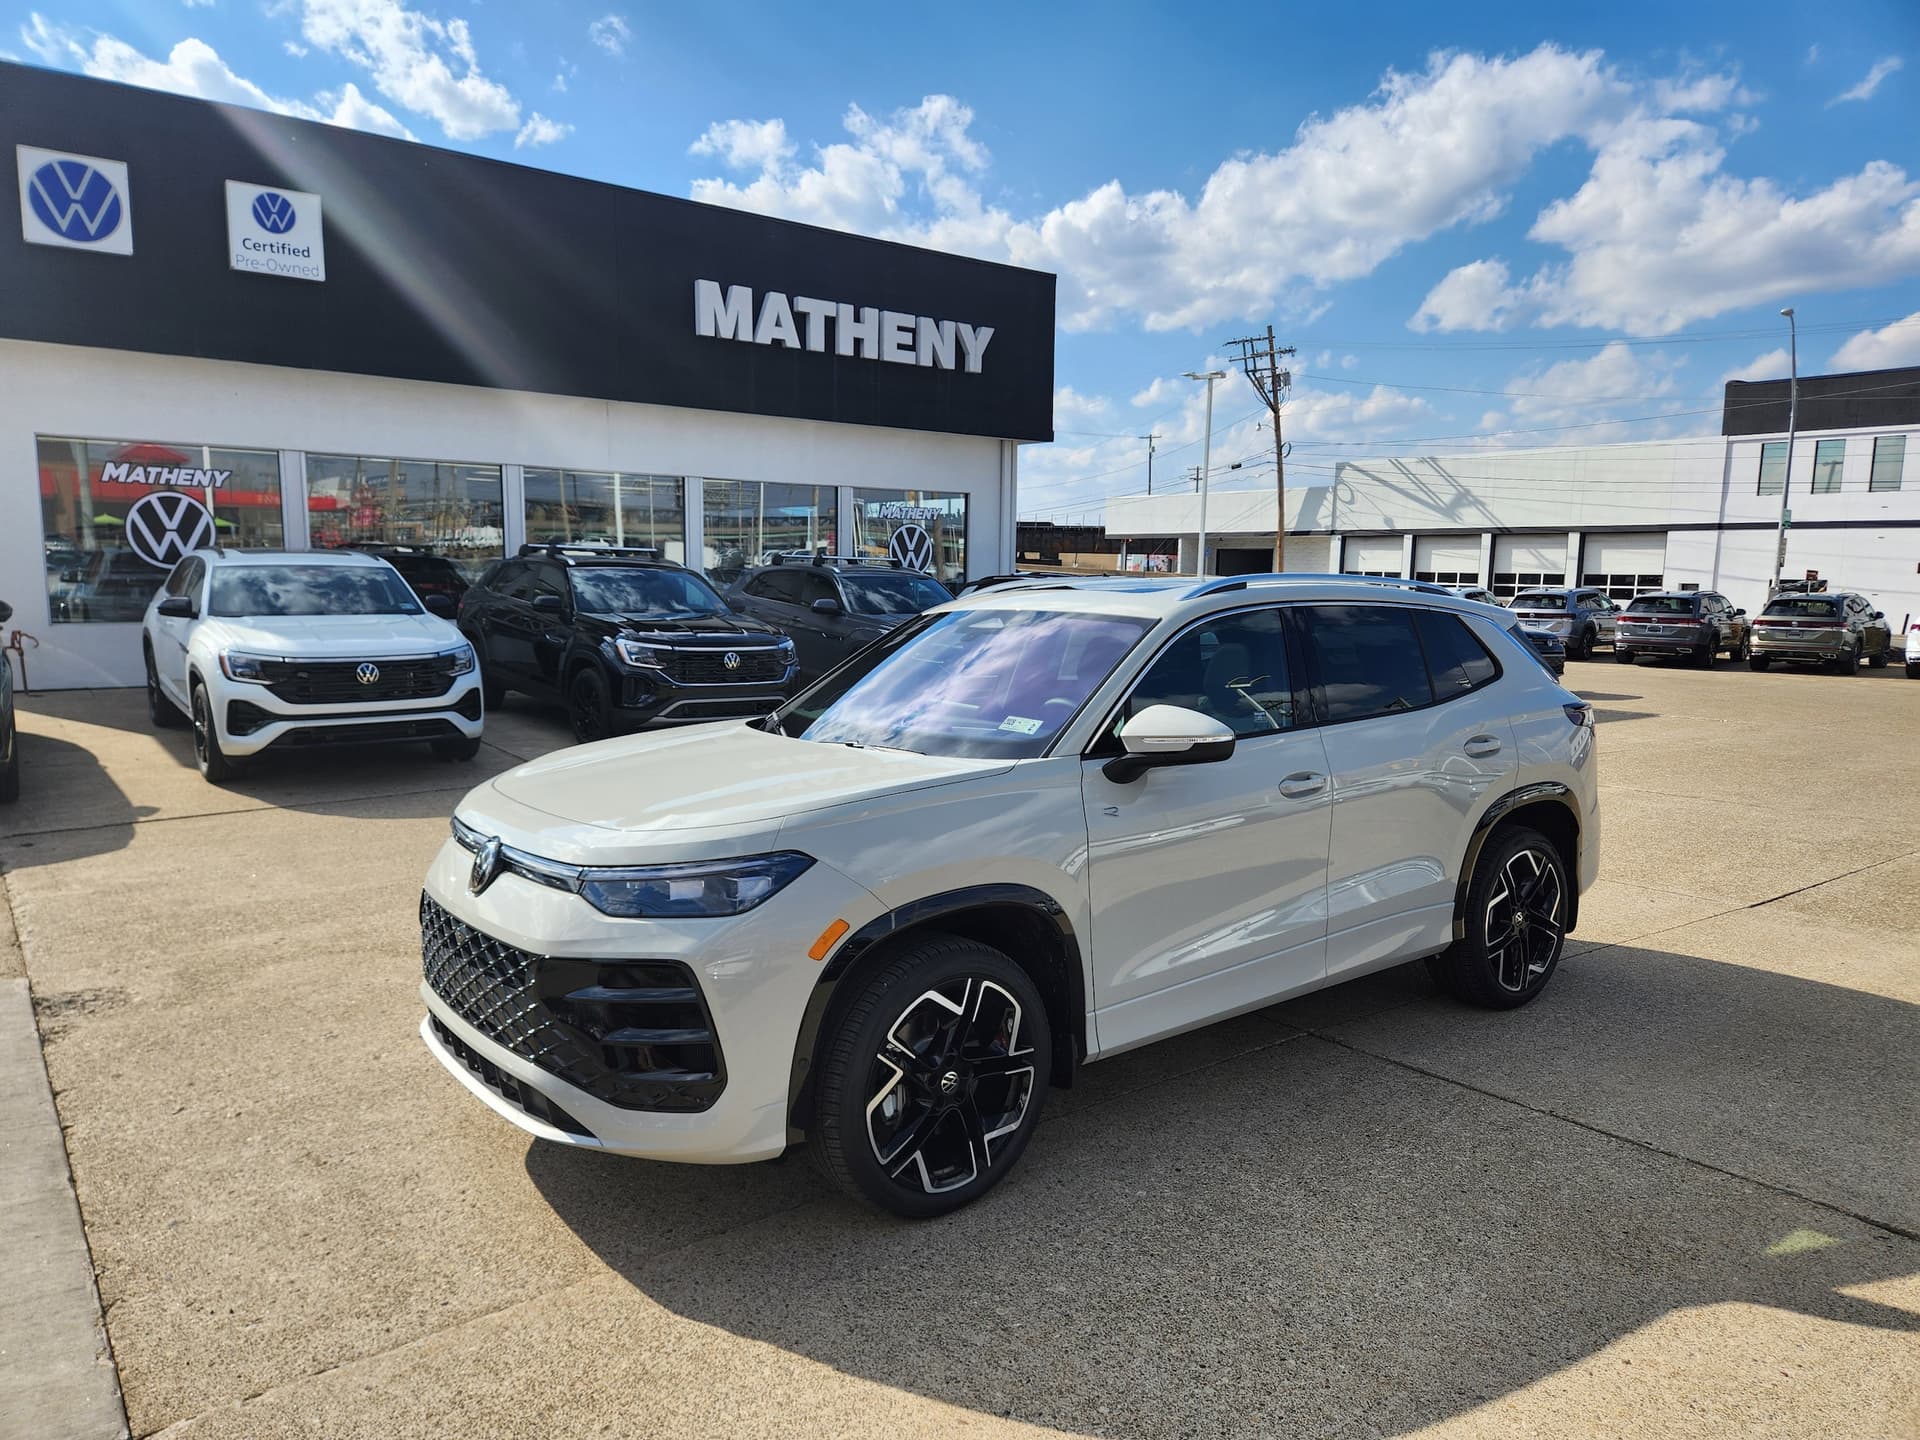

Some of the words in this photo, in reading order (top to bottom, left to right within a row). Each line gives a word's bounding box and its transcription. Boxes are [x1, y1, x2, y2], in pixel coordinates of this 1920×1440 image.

[242, 238, 311, 258] Certified
[235, 254, 320, 277] Pre-Owned
[694, 279, 995, 374] MATHENY
[100, 461, 232, 488] MATHENY
[880, 505, 943, 520] MATHENY
